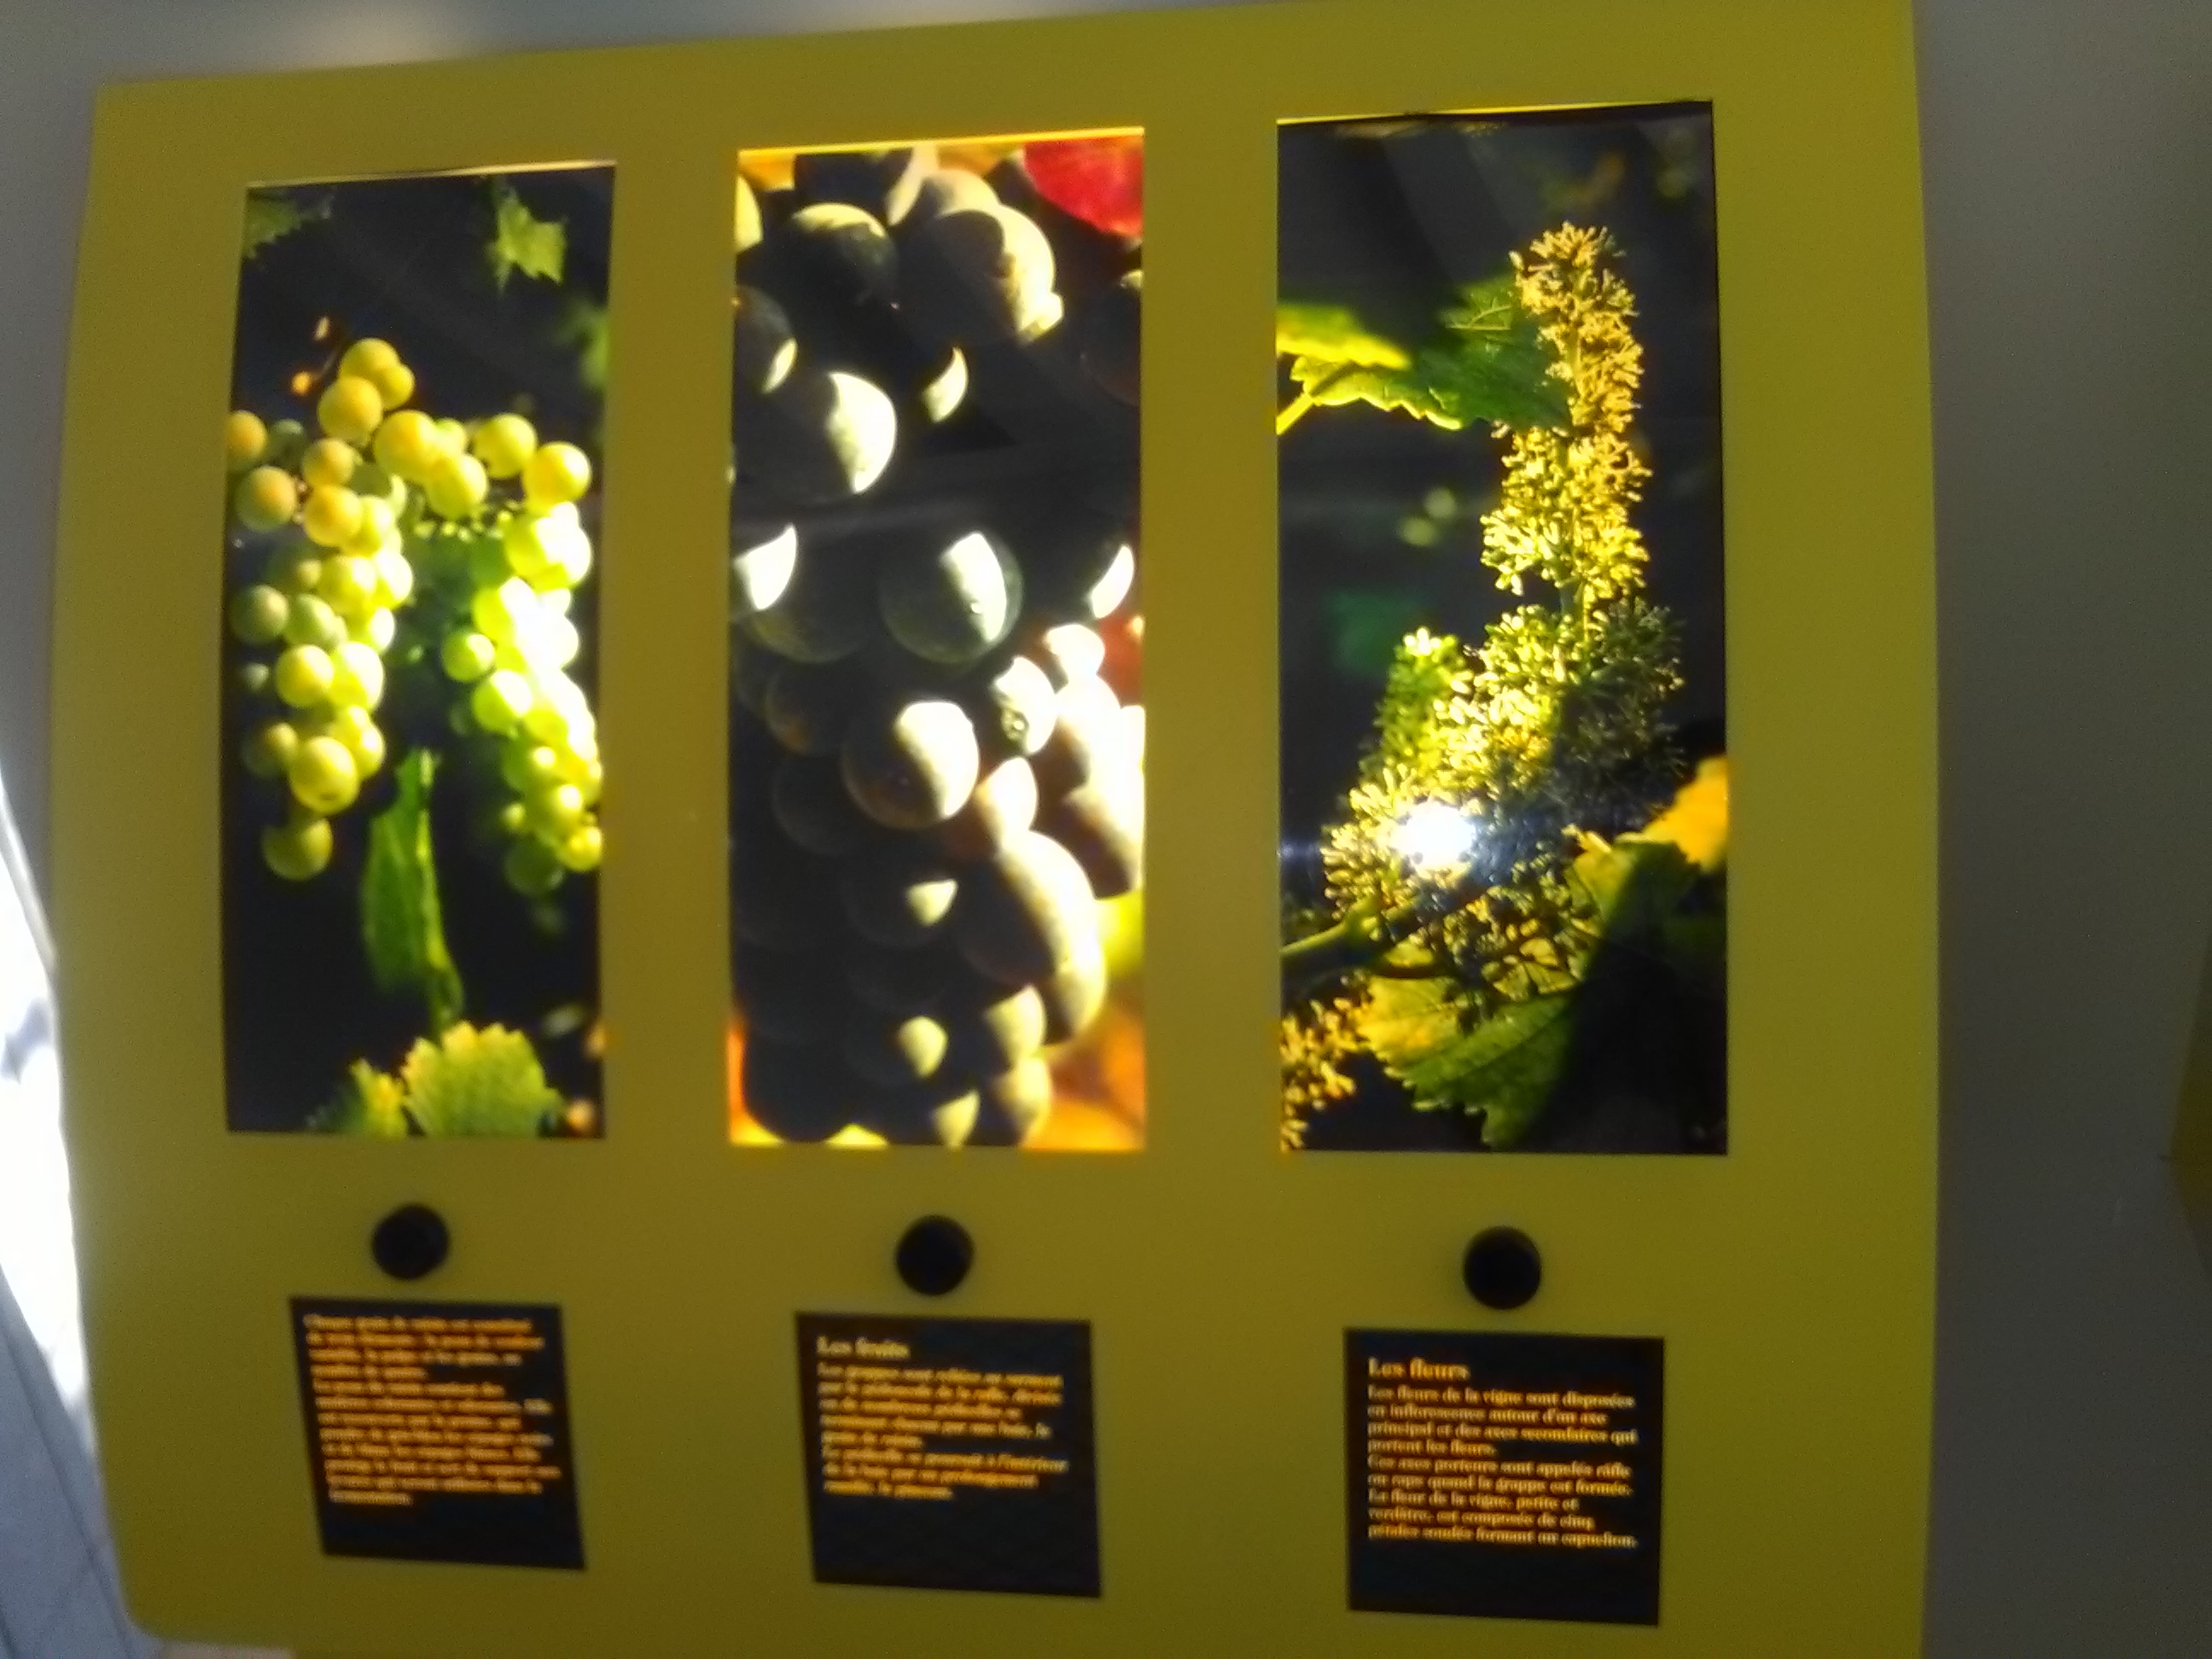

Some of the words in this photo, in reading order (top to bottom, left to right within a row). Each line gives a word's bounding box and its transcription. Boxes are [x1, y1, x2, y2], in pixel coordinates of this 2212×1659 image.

[817, 1336, 852, 1355] Les
[1368, 1357, 1406, 1377] Les
[1368, 1384, 1394, 1400] Les
[1442, 1387, 1461, 1401] de
[1464, 1388, 1480, 1403] la
